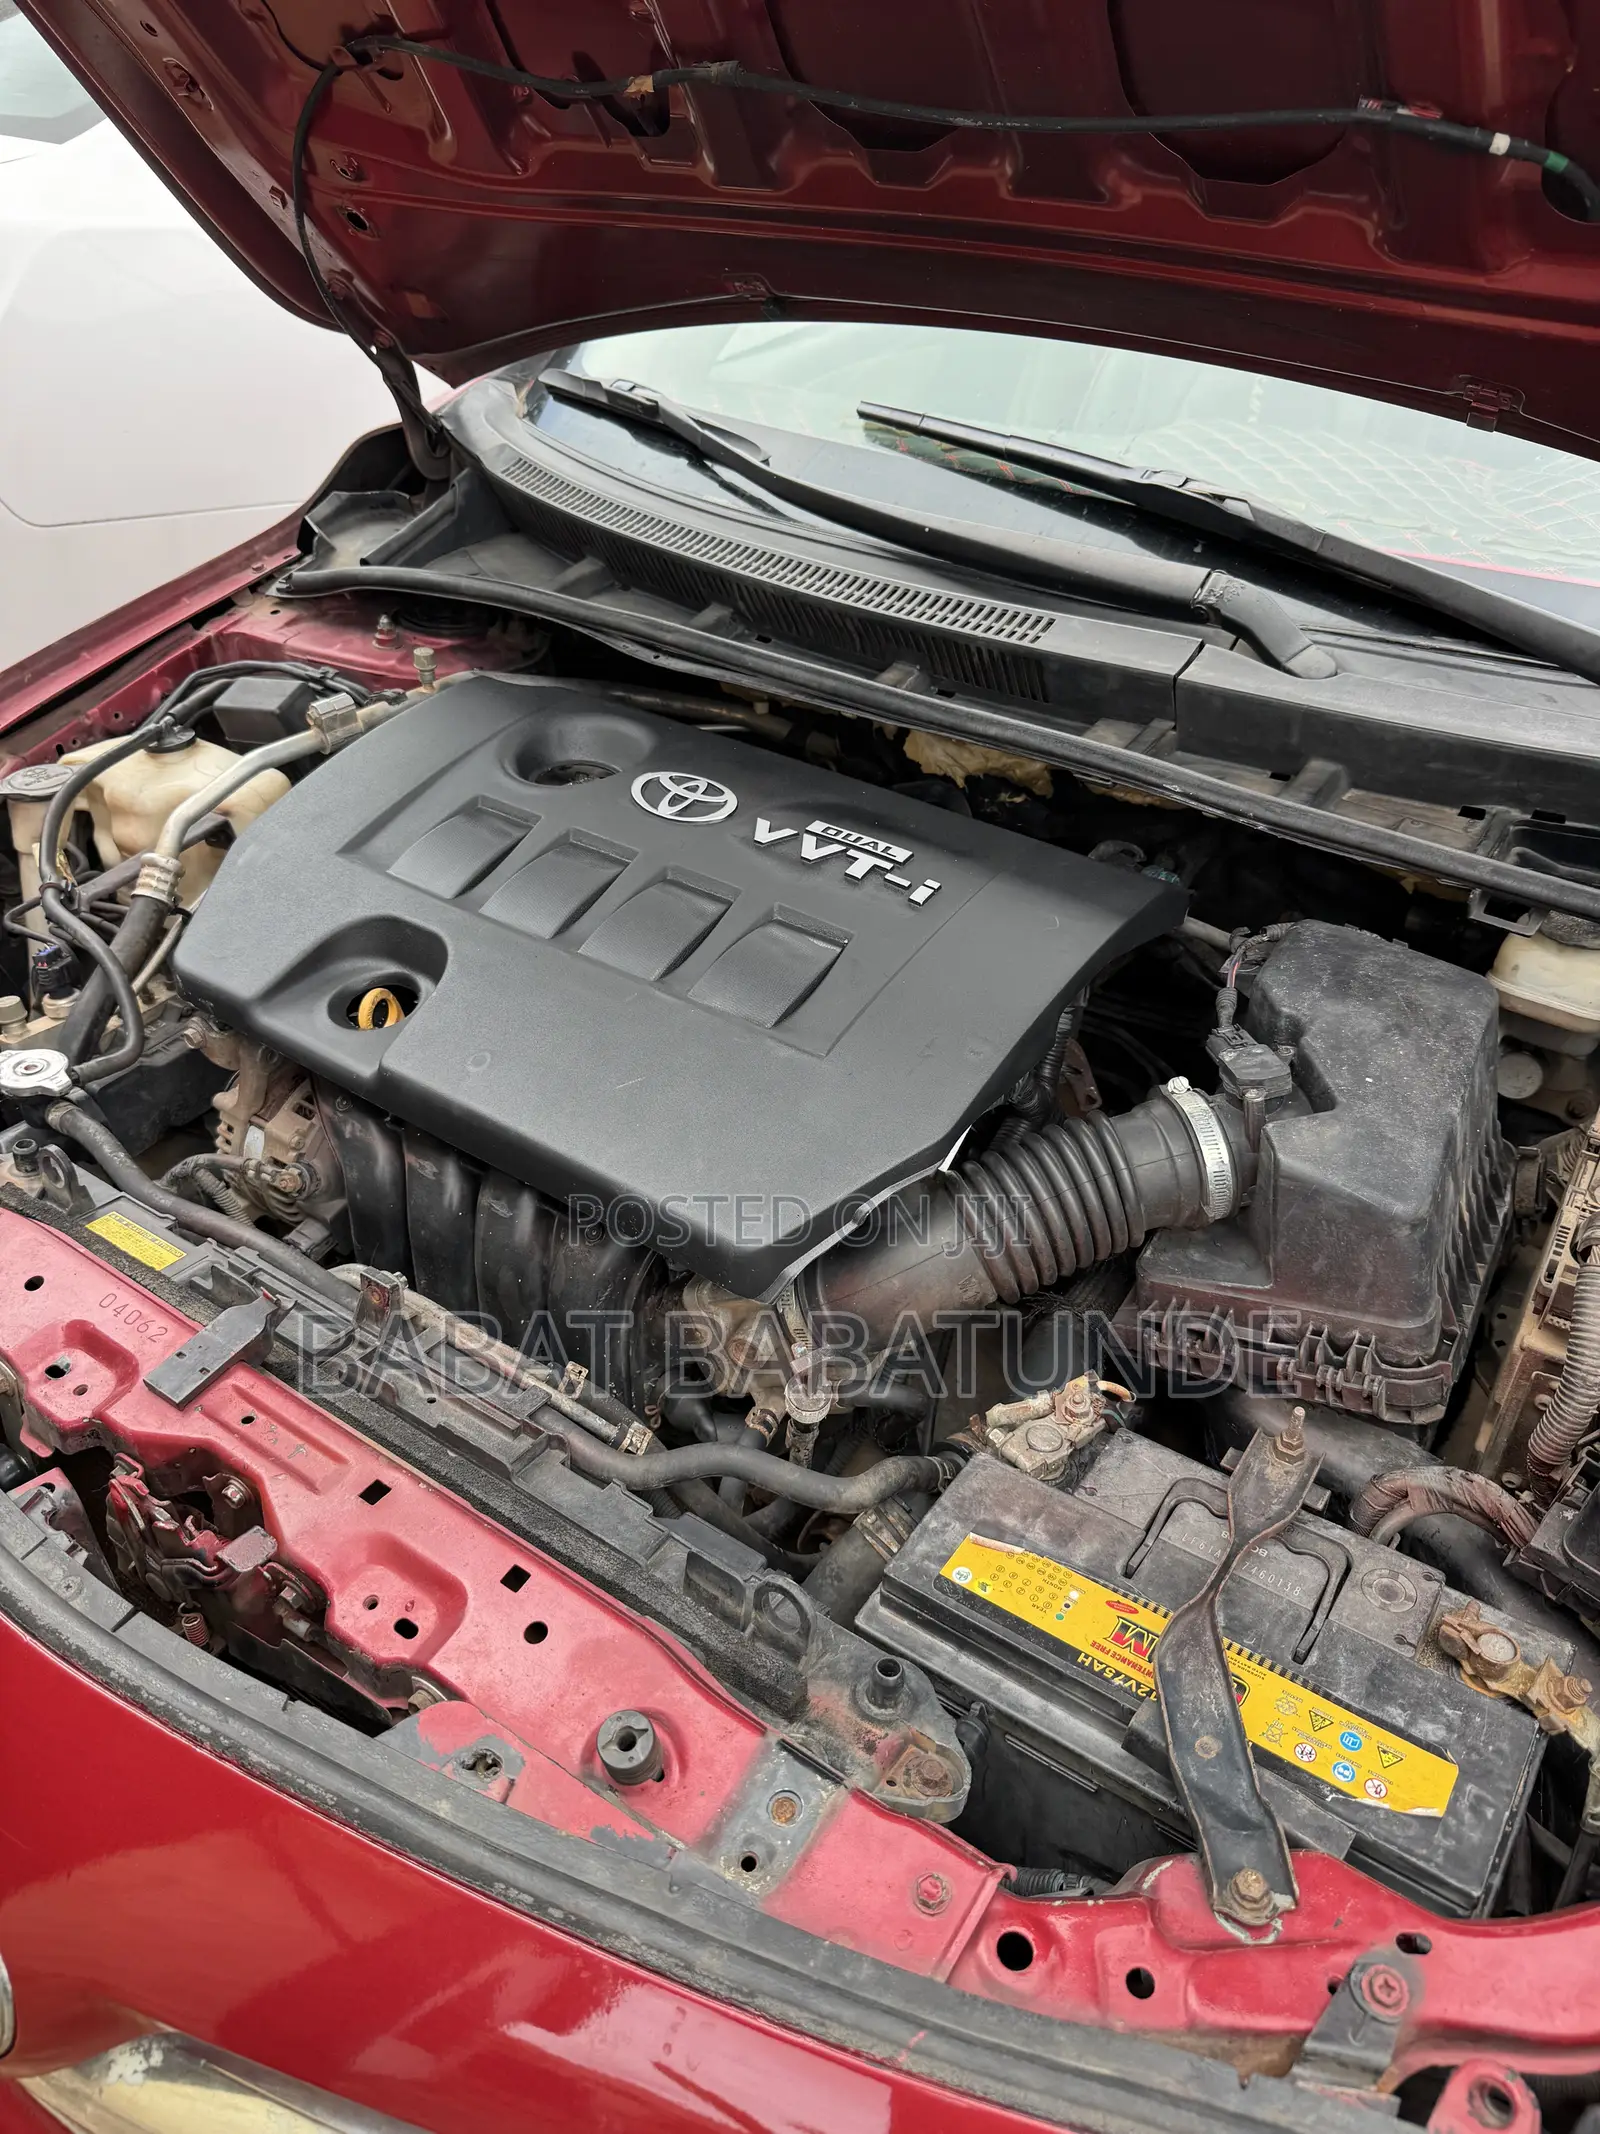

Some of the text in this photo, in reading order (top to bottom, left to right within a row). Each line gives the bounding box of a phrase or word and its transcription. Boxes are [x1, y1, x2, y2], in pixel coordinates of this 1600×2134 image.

[818, 823, 901, 860] DUAL
[753, 817, 942, 907] VVT-i
[99, 1293, 168, 1342] 04062
[1041, 1577, 1063, 1591] MONTH
[1030, 1601, 1048, 1614] YEAR
[1090, 1639, 1112, 1656] FREE
[1077, 1652, 1158, 1702] 12V75AH
